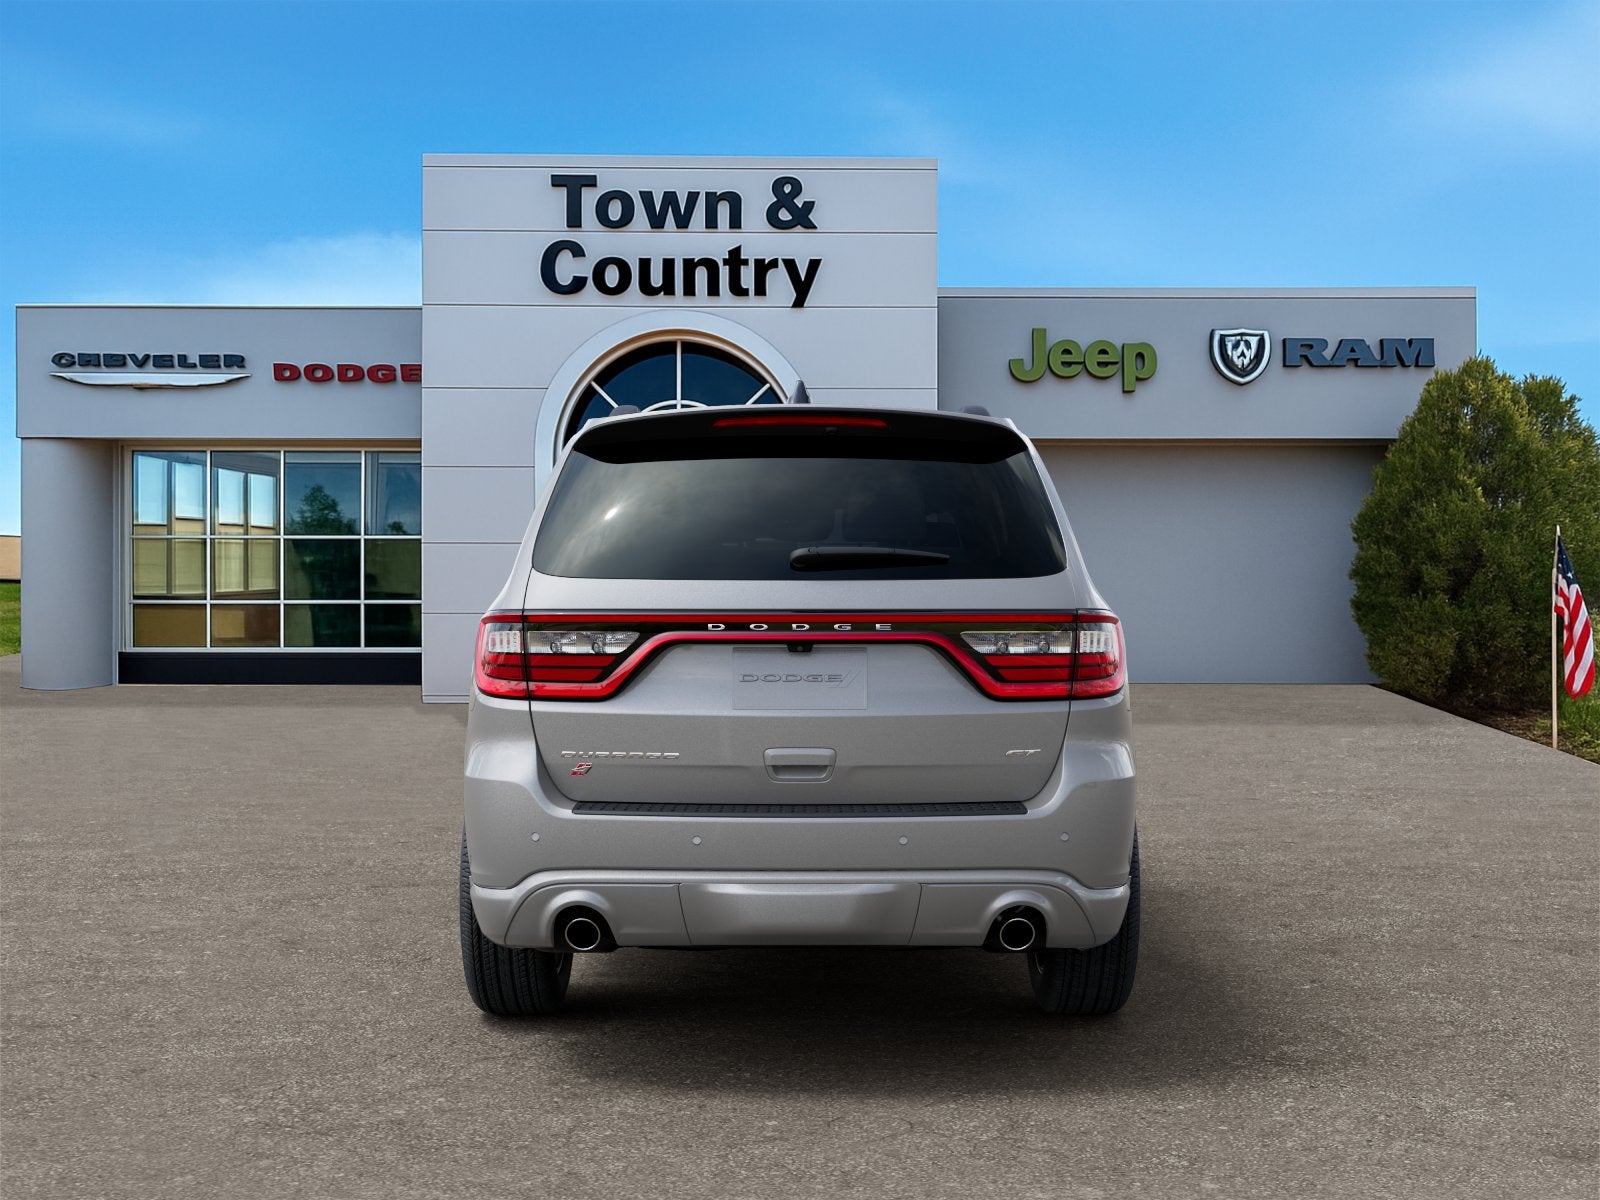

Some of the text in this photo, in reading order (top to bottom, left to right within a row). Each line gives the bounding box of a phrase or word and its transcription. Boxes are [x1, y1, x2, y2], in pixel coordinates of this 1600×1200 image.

[550, 174, 818, 229] Town &
[540, 239, 822, 308] Country
[1009, 328, 1157, 393] Jeep
[1282, 337, 1435, 368] RAM
[273, 363, 422, 383] DODGE
[707, 623, 892, 631] DODGE
[738, 674, 843, 683] DODGE
